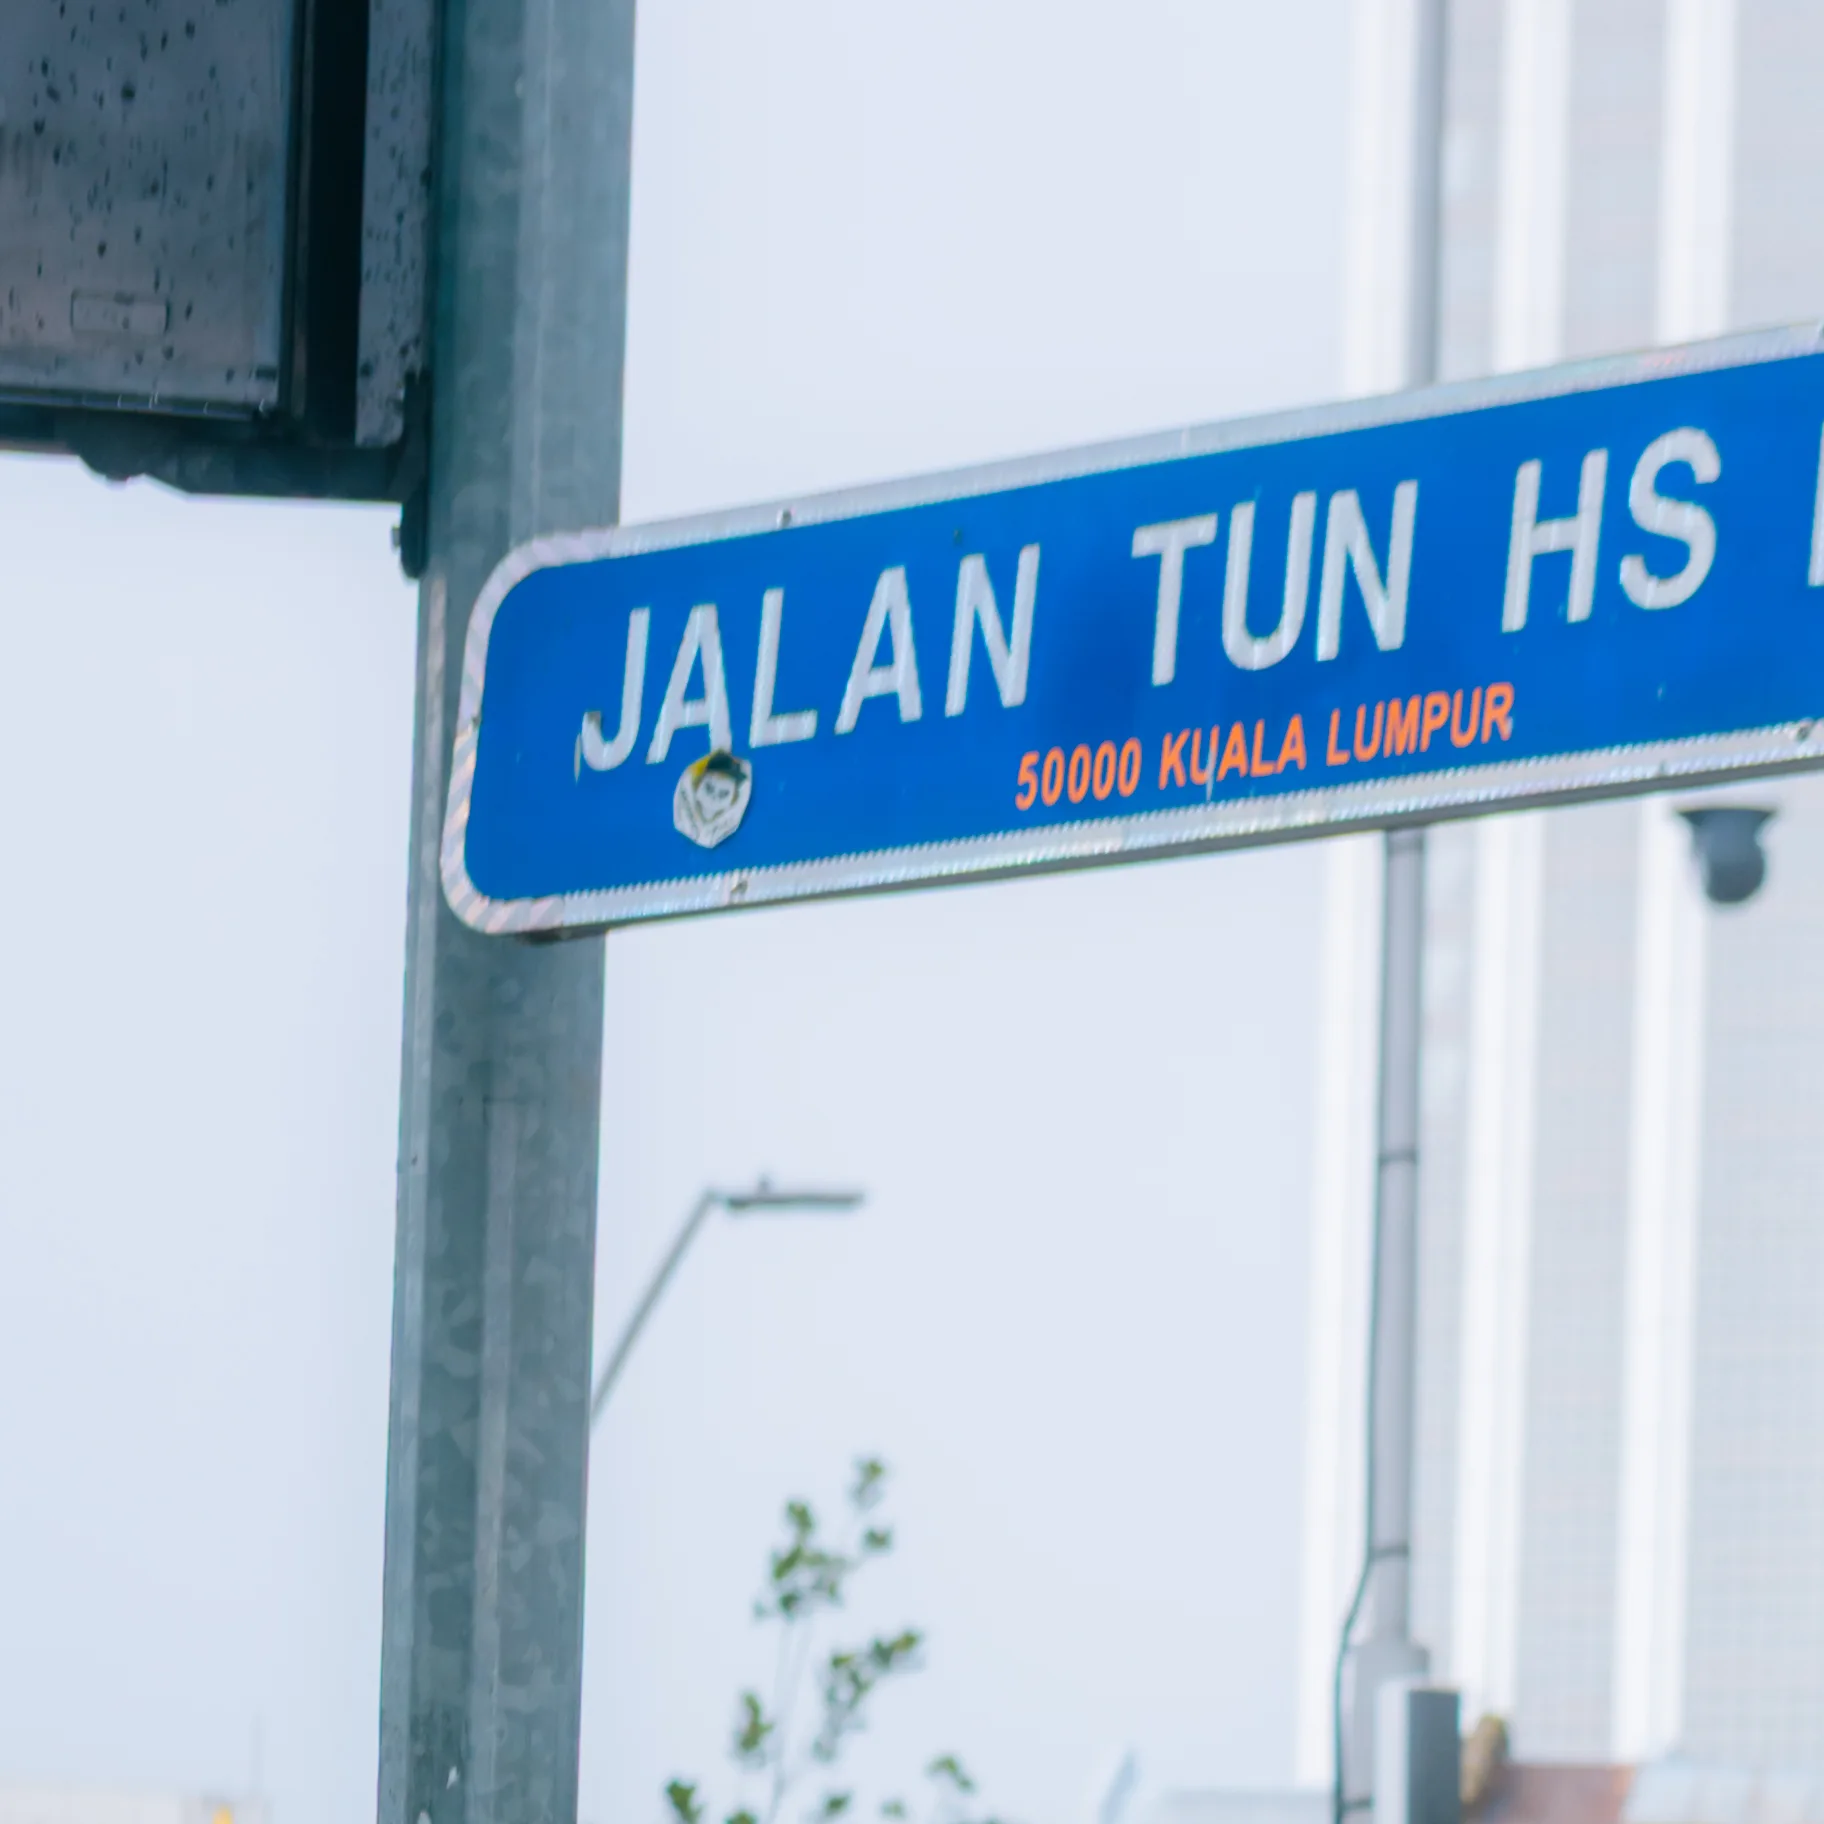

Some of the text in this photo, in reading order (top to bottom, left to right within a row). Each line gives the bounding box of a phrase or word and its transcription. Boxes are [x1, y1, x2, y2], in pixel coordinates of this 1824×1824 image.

[577, 545, 1040, 773] JALAN
[1132, 480, 1418, 685] TUN
[1502, 427, 1721, 632] HS
[1015, 681, 1515, 810] 50000 KUALA LUMPUR
